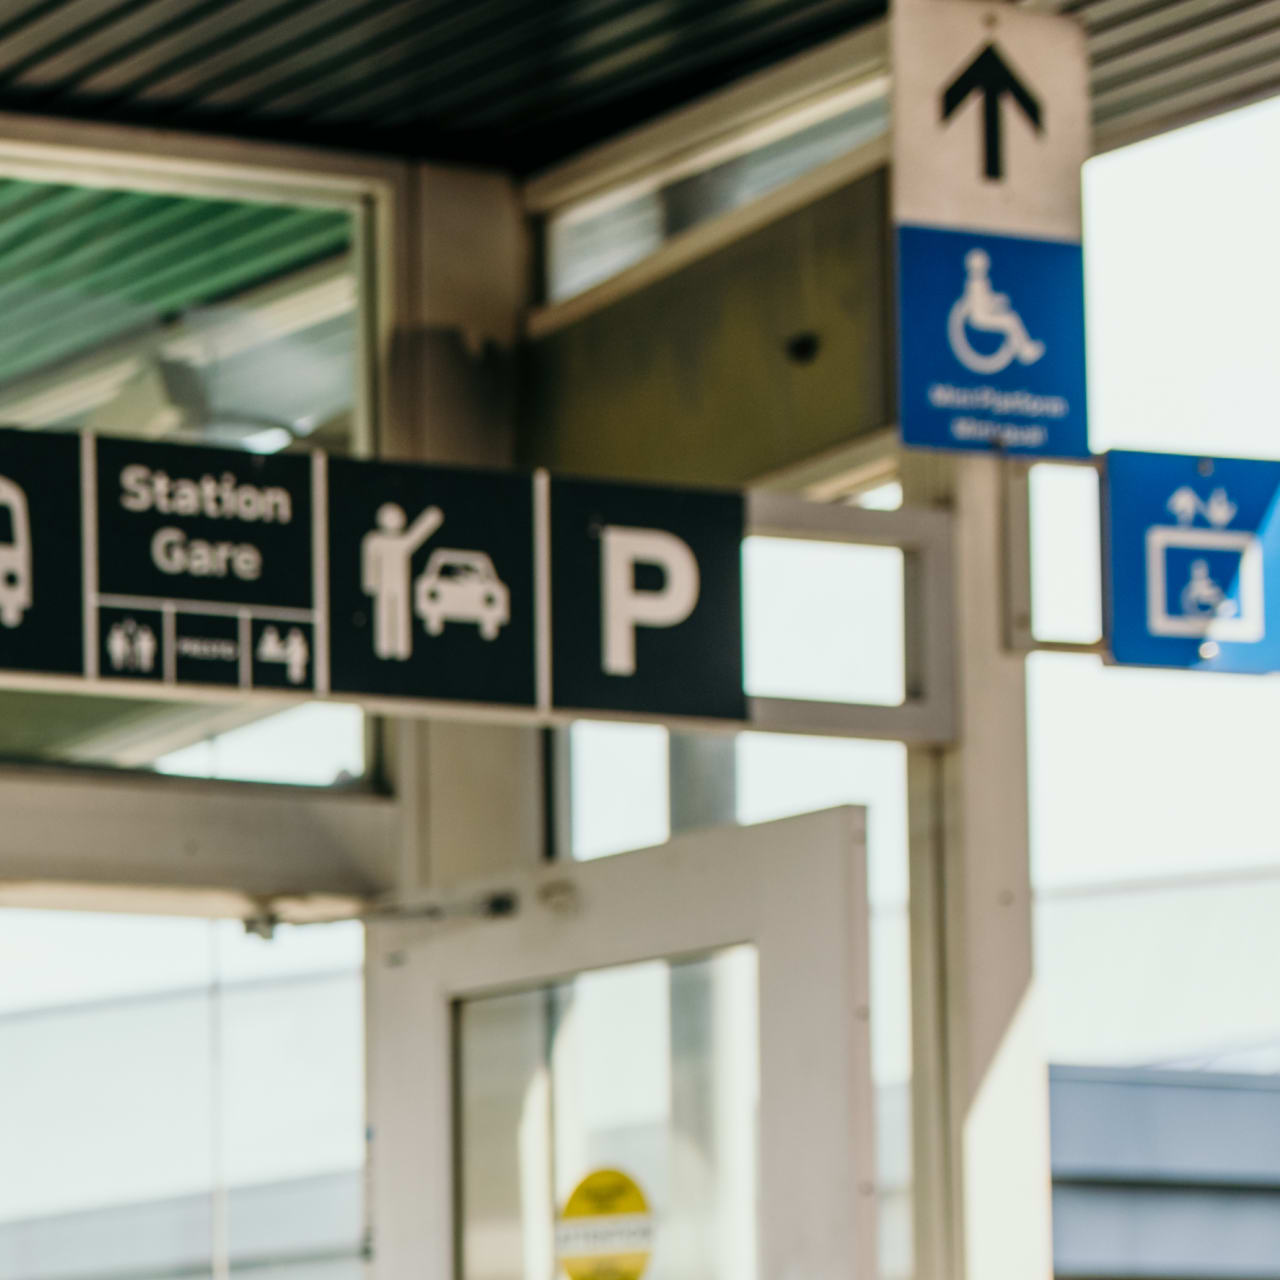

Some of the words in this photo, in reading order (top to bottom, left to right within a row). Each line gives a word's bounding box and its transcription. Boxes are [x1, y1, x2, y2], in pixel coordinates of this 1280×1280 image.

[120, 464, 292, 525] Station
[151, 526, 263, 581] Gare
[600, 525, 701, 677] P
